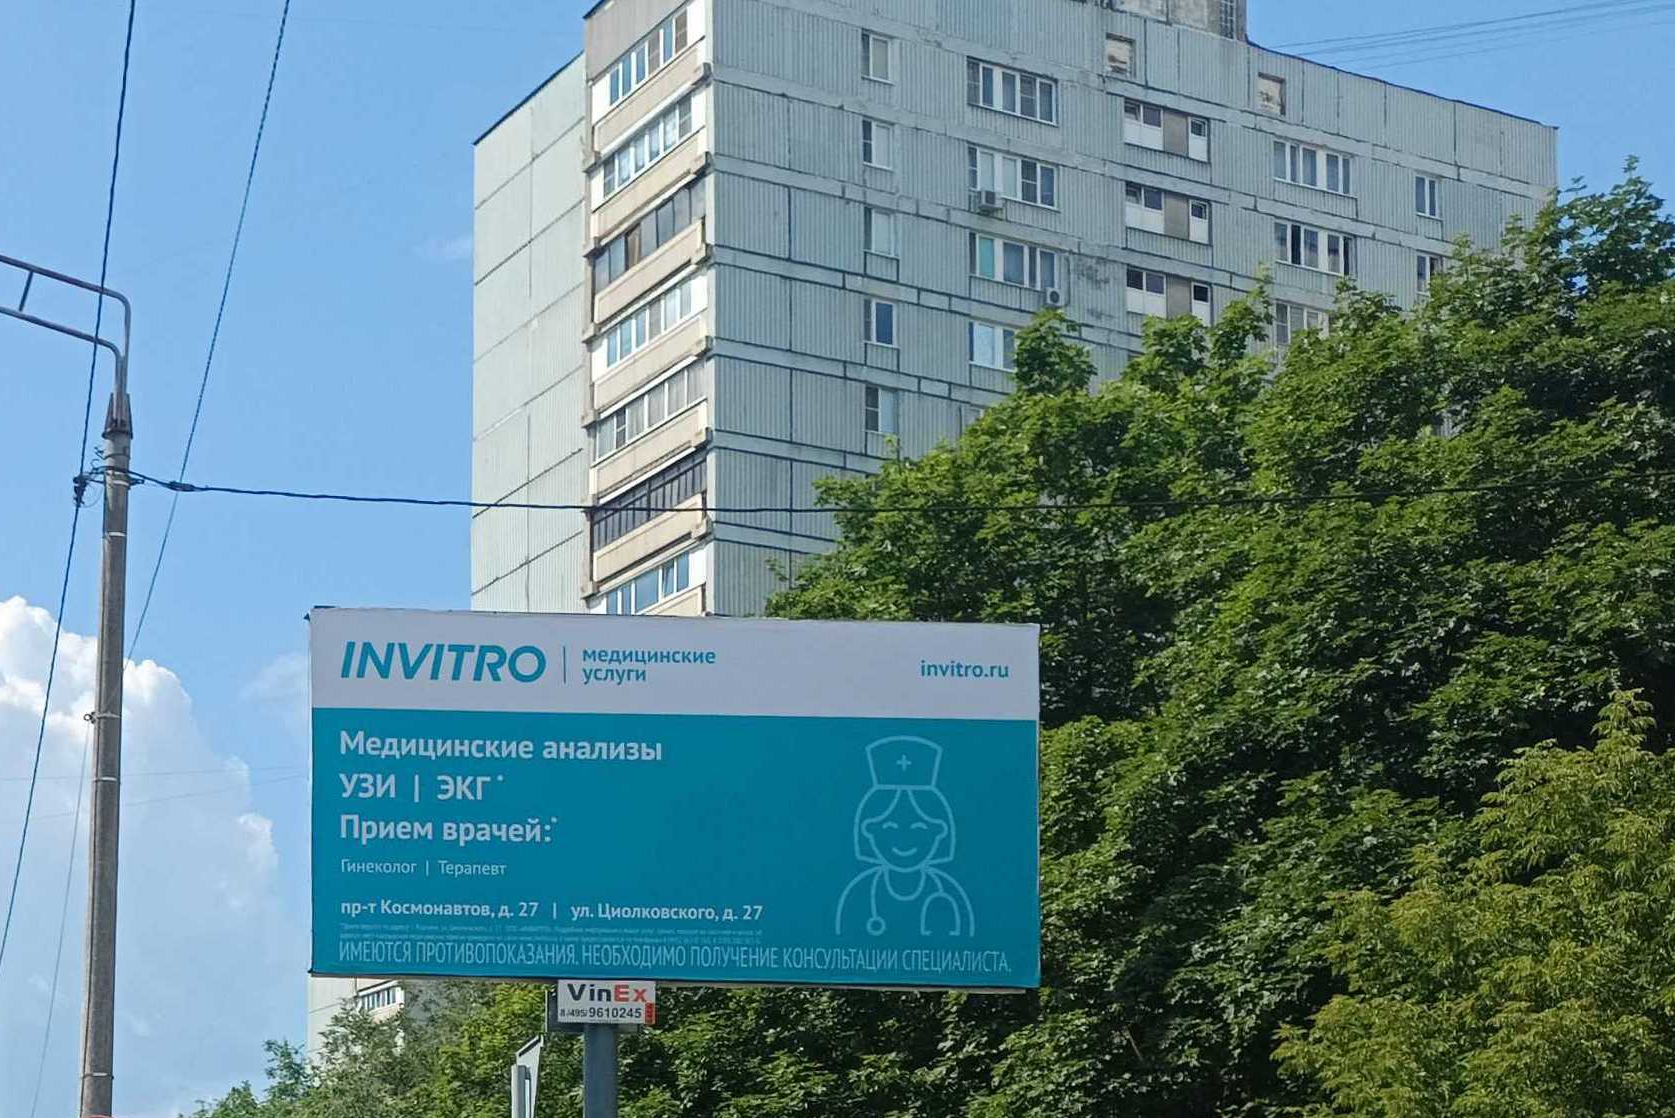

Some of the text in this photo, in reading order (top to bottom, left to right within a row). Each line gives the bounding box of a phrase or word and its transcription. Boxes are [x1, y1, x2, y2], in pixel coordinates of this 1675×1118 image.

[340, 640, 547, 684] INVITRO
[582, 649, 716, 665] медицинские
[582, 667, 647, 685] услуги
[920, 658, 1010, 679] invitro.ru
[339, 730, 663, 761] Медицинские анализы
[339, 773, 397, 799] УЗИ
[340, 814, 433, 845] Прием
[340, 859, 507, 878] Гинеколог Терапевт
[341, 900, 539, 918] пр-т Космонавтов, д. 27
[571, 903, 763, 921] ул. Циолковского, д. 27
[339, 940, 1013, 974] ИМЕЮТСЯ ПРОТИВОПОКАЗАНИЯ. НЕОБХОДИМО ПОЛУЧЕНИЕ КОНСУЛЬТАЦИИ СПЕЦИАЛИСТА.
[567, 984, 647, 1002] VinEx
